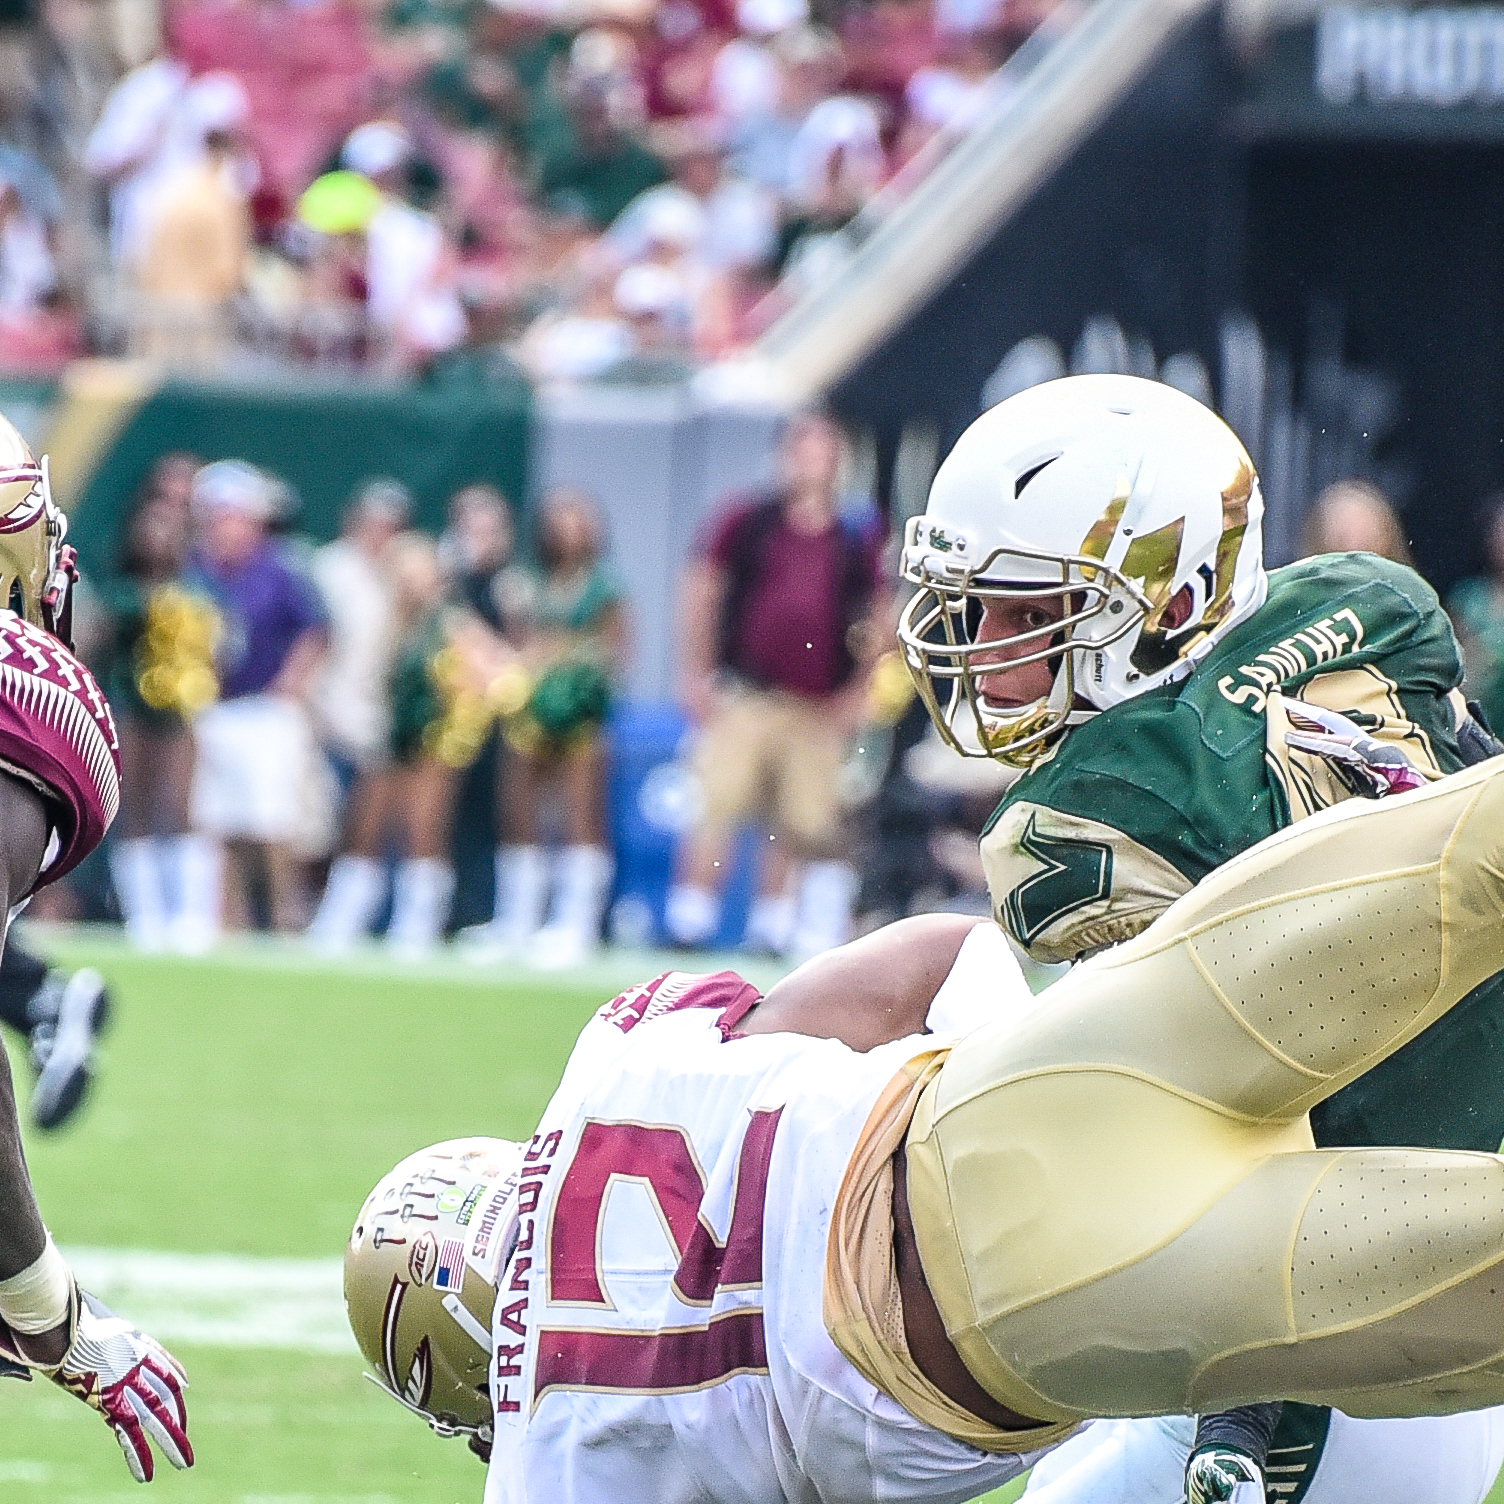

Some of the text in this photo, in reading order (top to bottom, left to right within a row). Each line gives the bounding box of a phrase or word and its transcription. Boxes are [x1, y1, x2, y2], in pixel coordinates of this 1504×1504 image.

[1217, 607, 1365, 714] SANCHEZ
[414, 1240, 429, 1284] ACC
[496, 1128, 563, 1414] FRANCOIS
[530, 1102, 786, 1423] 12
